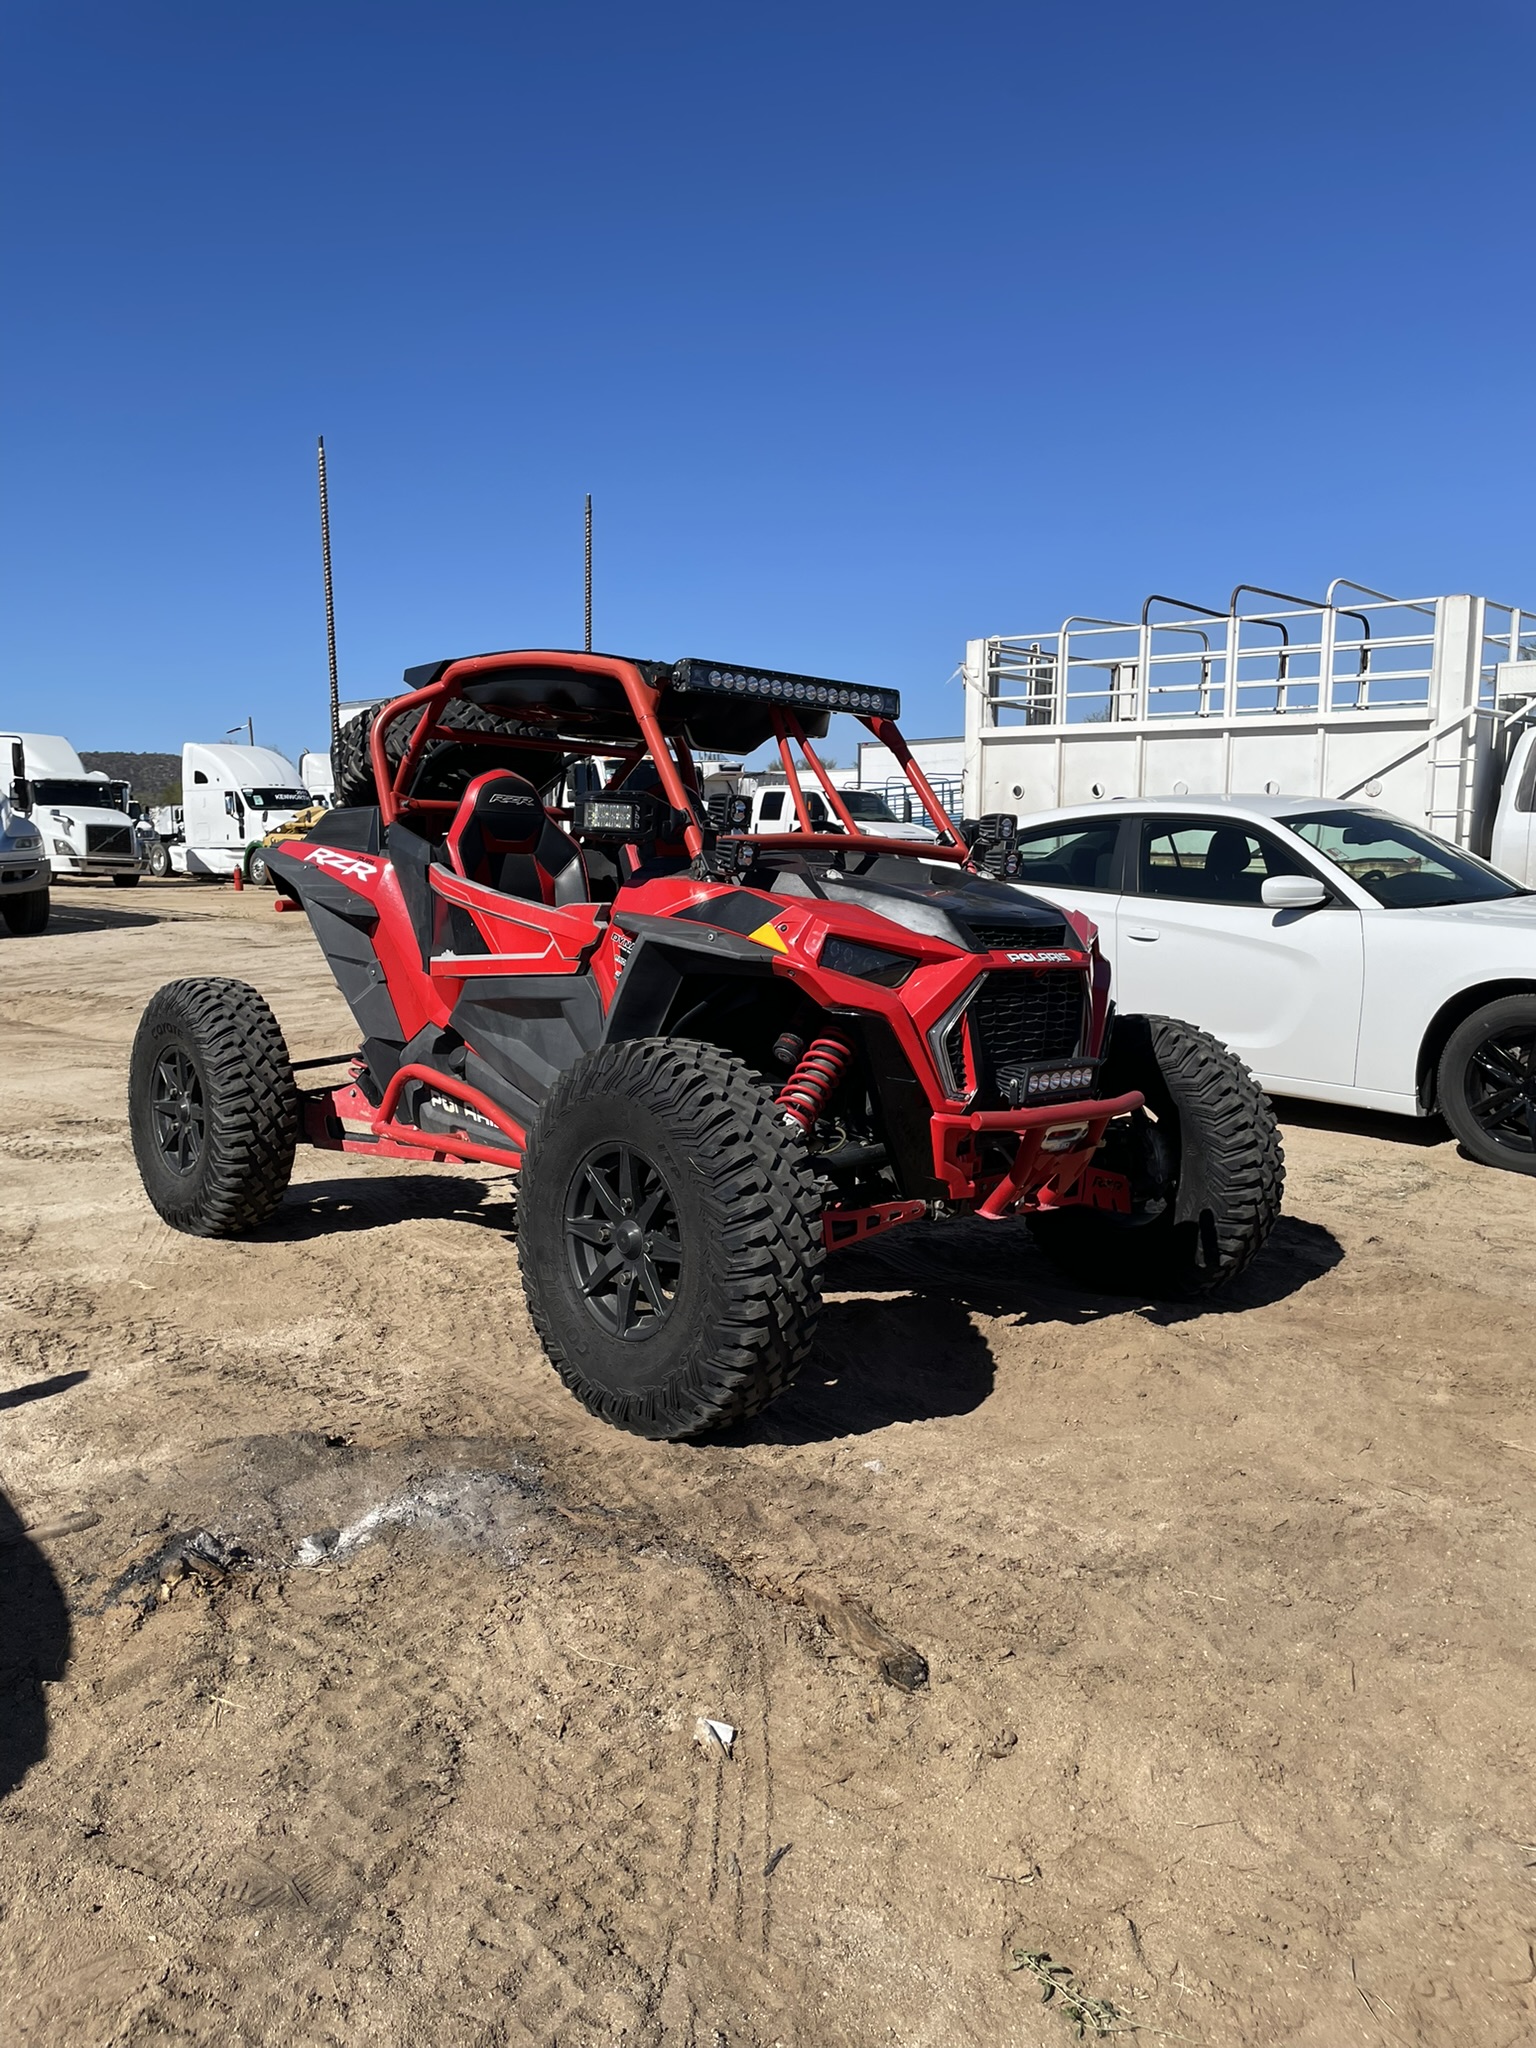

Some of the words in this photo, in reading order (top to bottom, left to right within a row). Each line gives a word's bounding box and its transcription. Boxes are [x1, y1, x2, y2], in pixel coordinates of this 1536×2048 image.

[274, 793, 309, 801] KENWORTH
[489, 794, 535, 806] RZR
[303, 847, 377, 882] RZR
[1006, 952, 1071, 963] POLARIS
[151, 1022, 184, 1040] COYOTE
[657, 1143, 682, 1179] ITP
